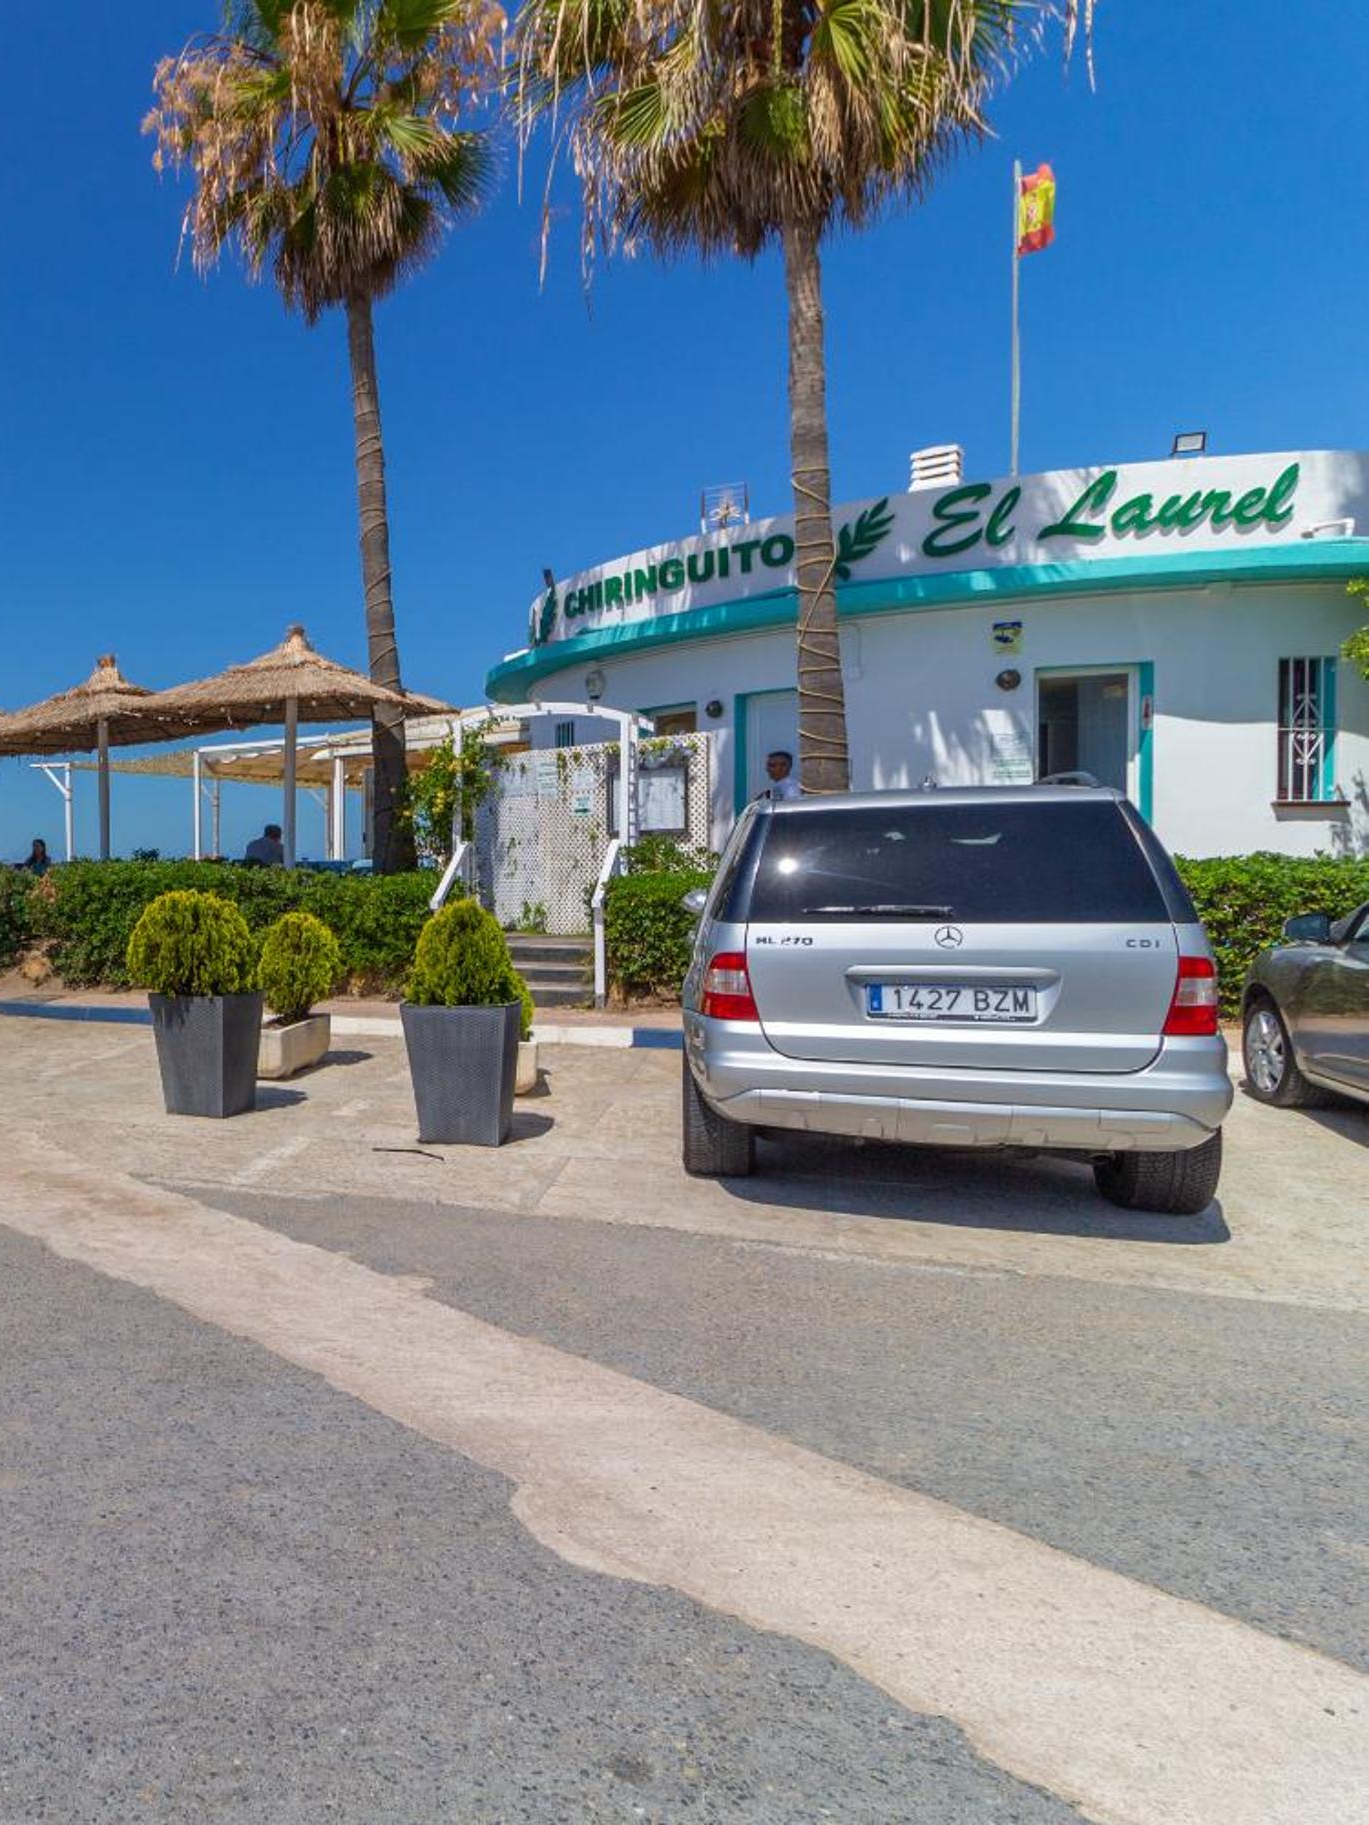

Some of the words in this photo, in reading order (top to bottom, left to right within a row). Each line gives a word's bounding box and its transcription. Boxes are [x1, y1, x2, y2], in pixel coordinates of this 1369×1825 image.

[564, 534, 795, 619] CHIRINGUITO
[922, 483, 1021, 557] El
[1038, 462, 1300, 540] Laurel
[1126, 939, 1159, 948] CDI
[893, 989, 960, 1011] 1427
[974, 990, 1029, 1012] BZM
